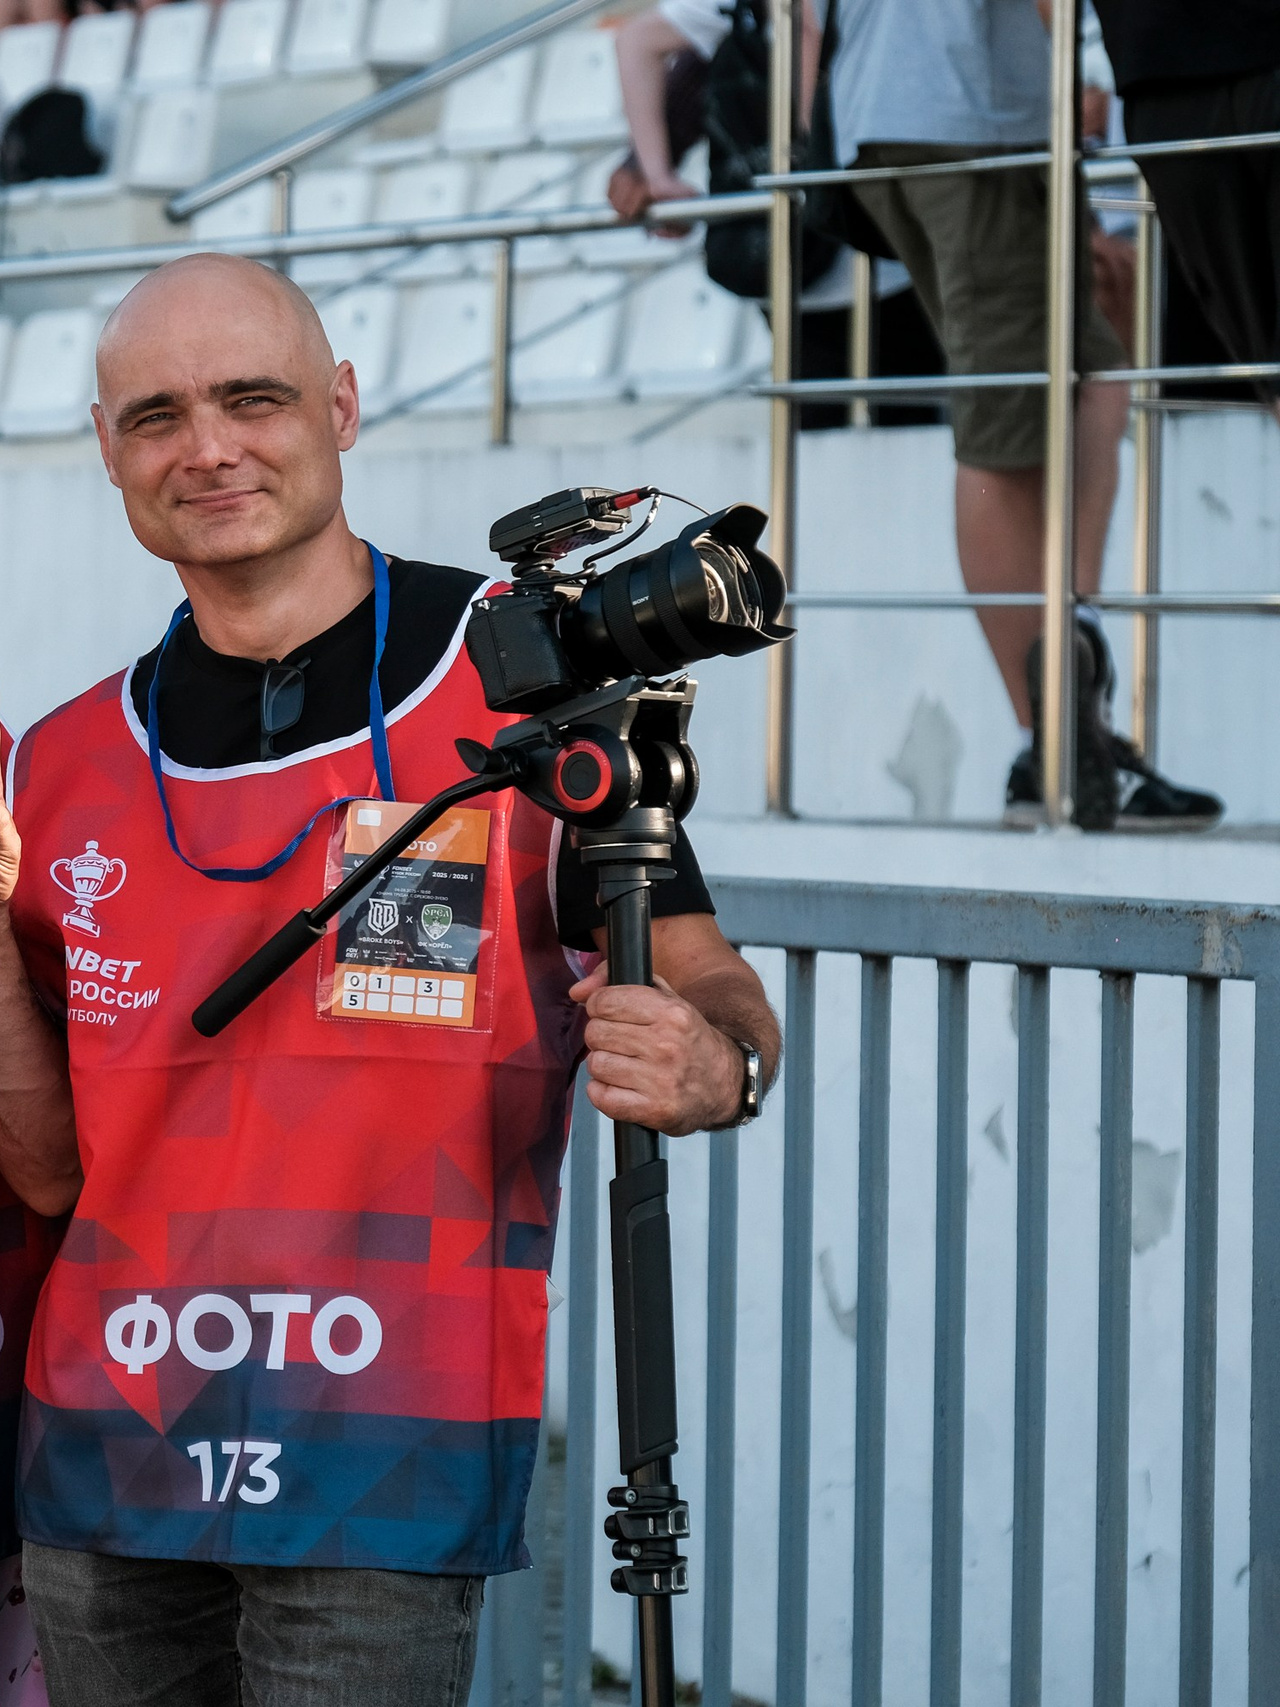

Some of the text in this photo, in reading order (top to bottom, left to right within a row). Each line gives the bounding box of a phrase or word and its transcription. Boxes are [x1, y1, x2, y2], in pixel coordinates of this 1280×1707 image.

[632, 595, 649, 605] SONY
[407, 840, 438, 852] ОТО
[65, 945, 142, 984] NBET
[69, 979, 162, 1010] РОССИИ
[424, 981, 432, 992] 3
[349, 995, 357, 1005] 5
[105, 1293, 383, 1375] ФОТО
[187, 1441, 282, 1505] 173
